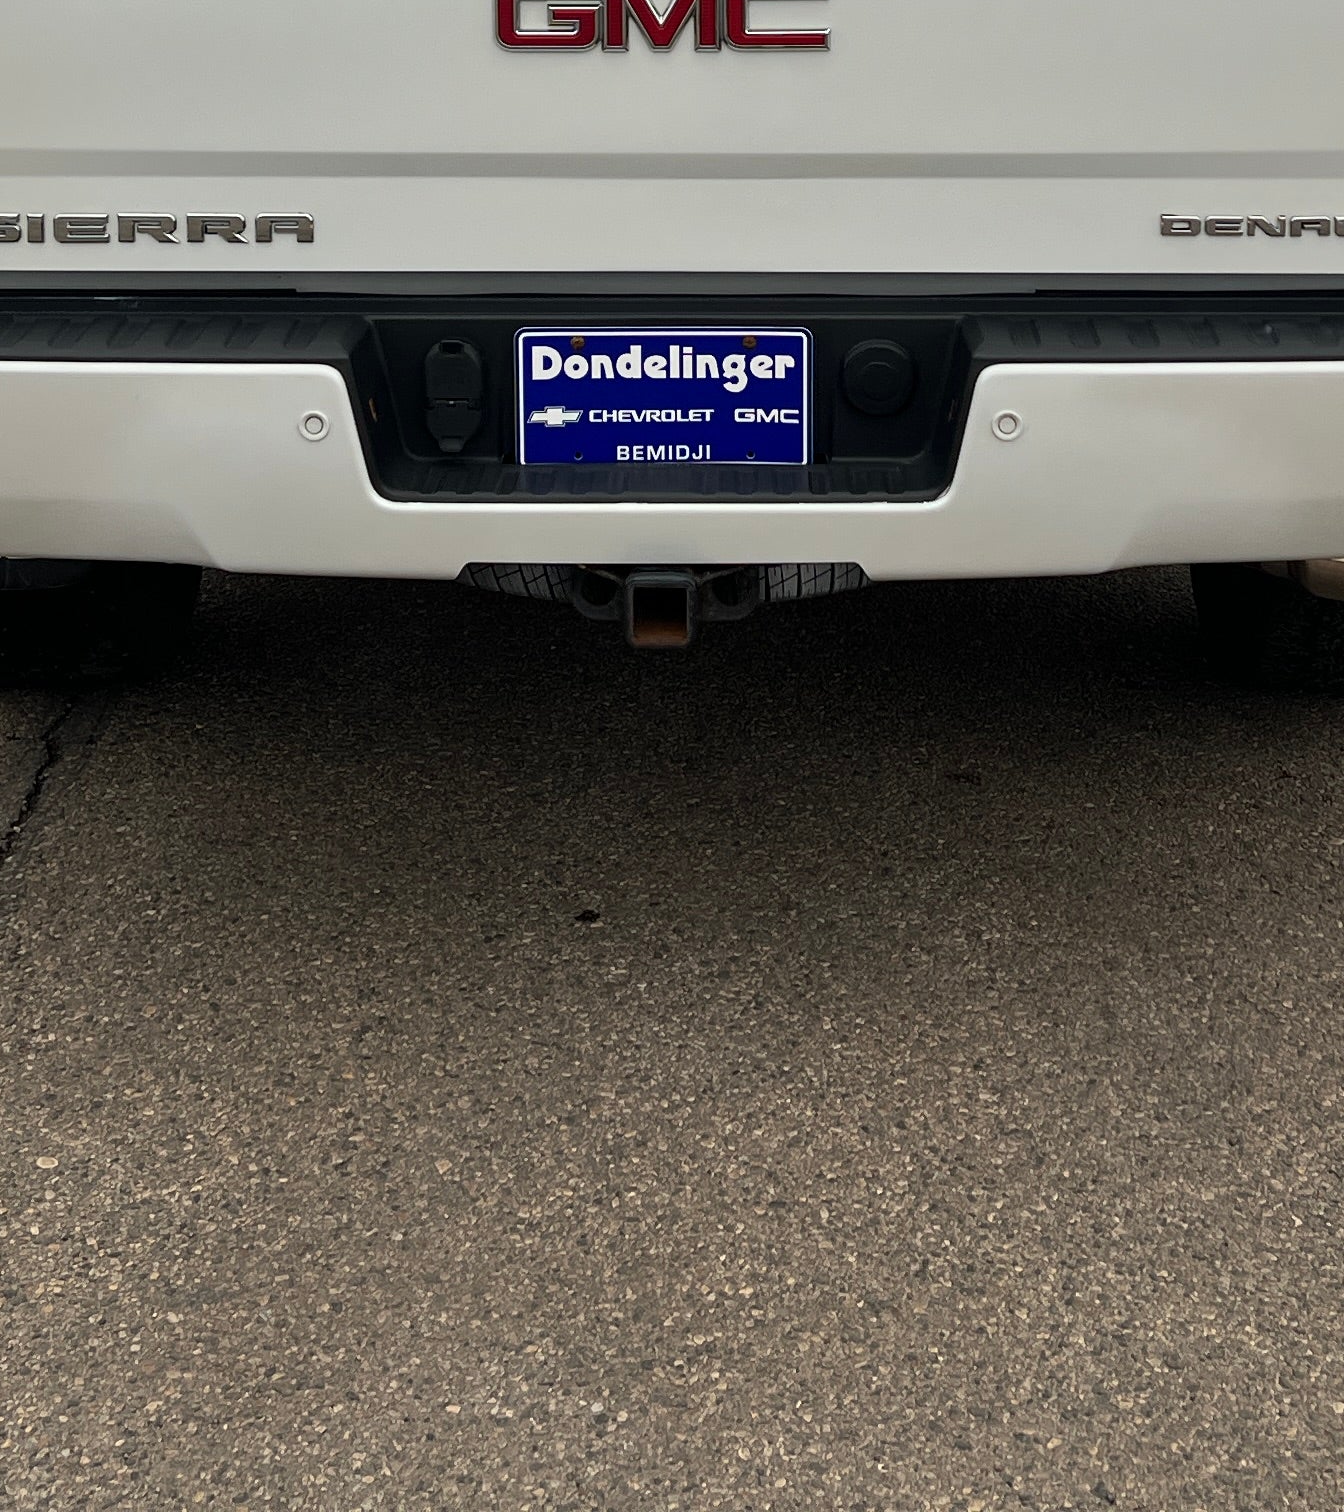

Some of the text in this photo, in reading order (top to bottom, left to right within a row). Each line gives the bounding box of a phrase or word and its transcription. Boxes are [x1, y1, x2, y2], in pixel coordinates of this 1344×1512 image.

[531, 345, 796, 393] Dondelinger
[588, 408, 800, 424] CHEVROLET GMC
[616, 445, 712, 461] BEMIDJI
